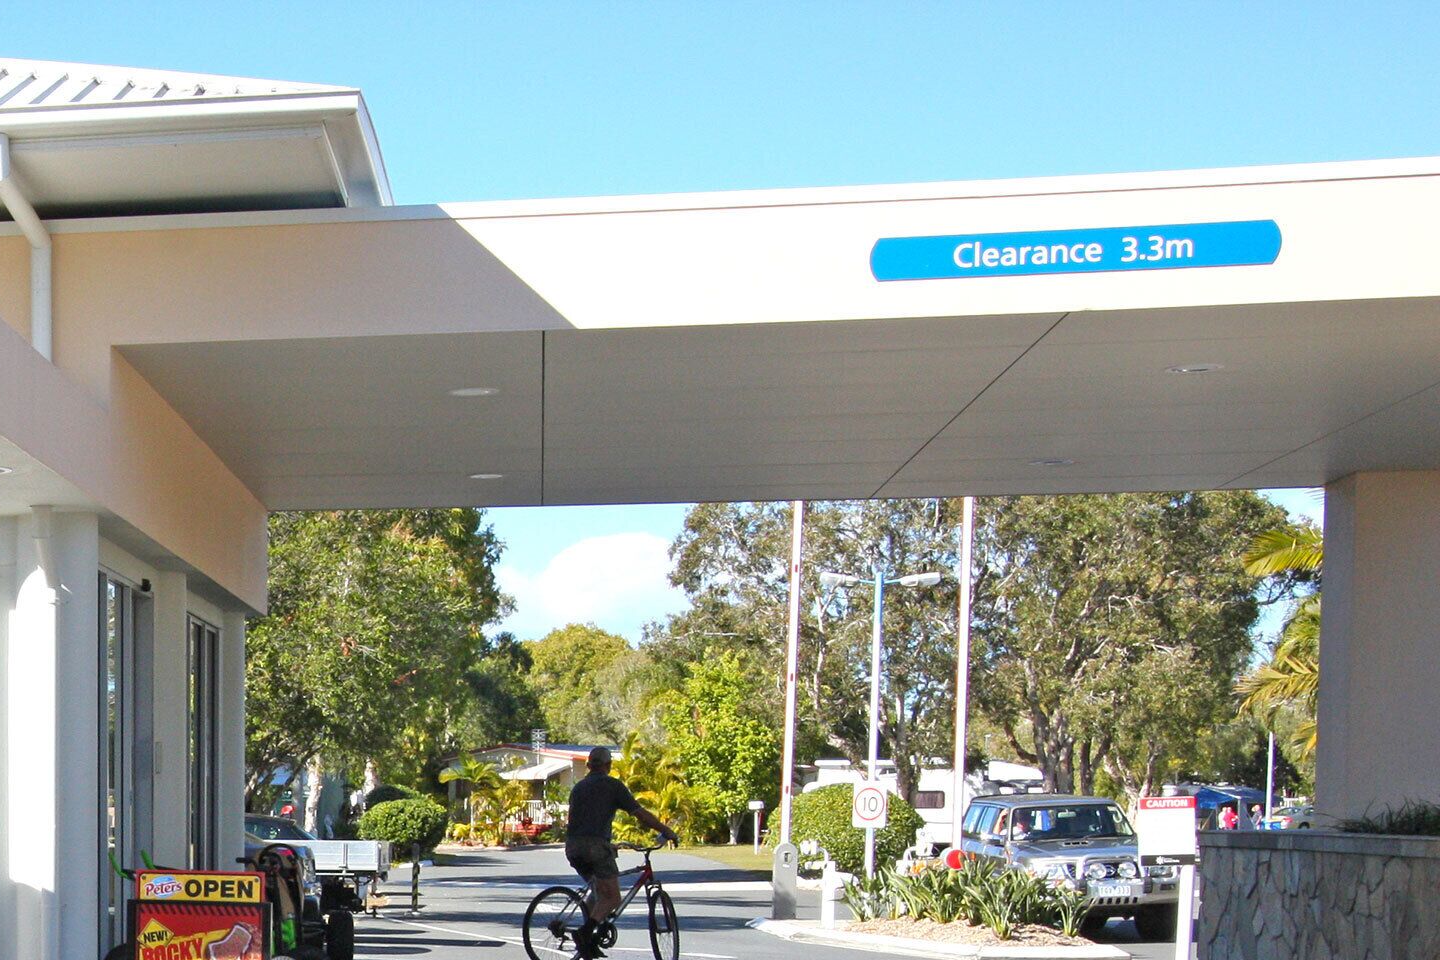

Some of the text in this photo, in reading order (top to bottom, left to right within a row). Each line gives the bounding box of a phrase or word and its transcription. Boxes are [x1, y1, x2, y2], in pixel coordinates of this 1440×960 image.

[953, 235, 1193, 268] Clearance 3.3m
[863, 797, 878, 812] 10
[1146, 799, 1188, 808] CAUTION
[145, 878, 253, 899] Peters OPEN
[143, 931, 168, 944] NEW!
